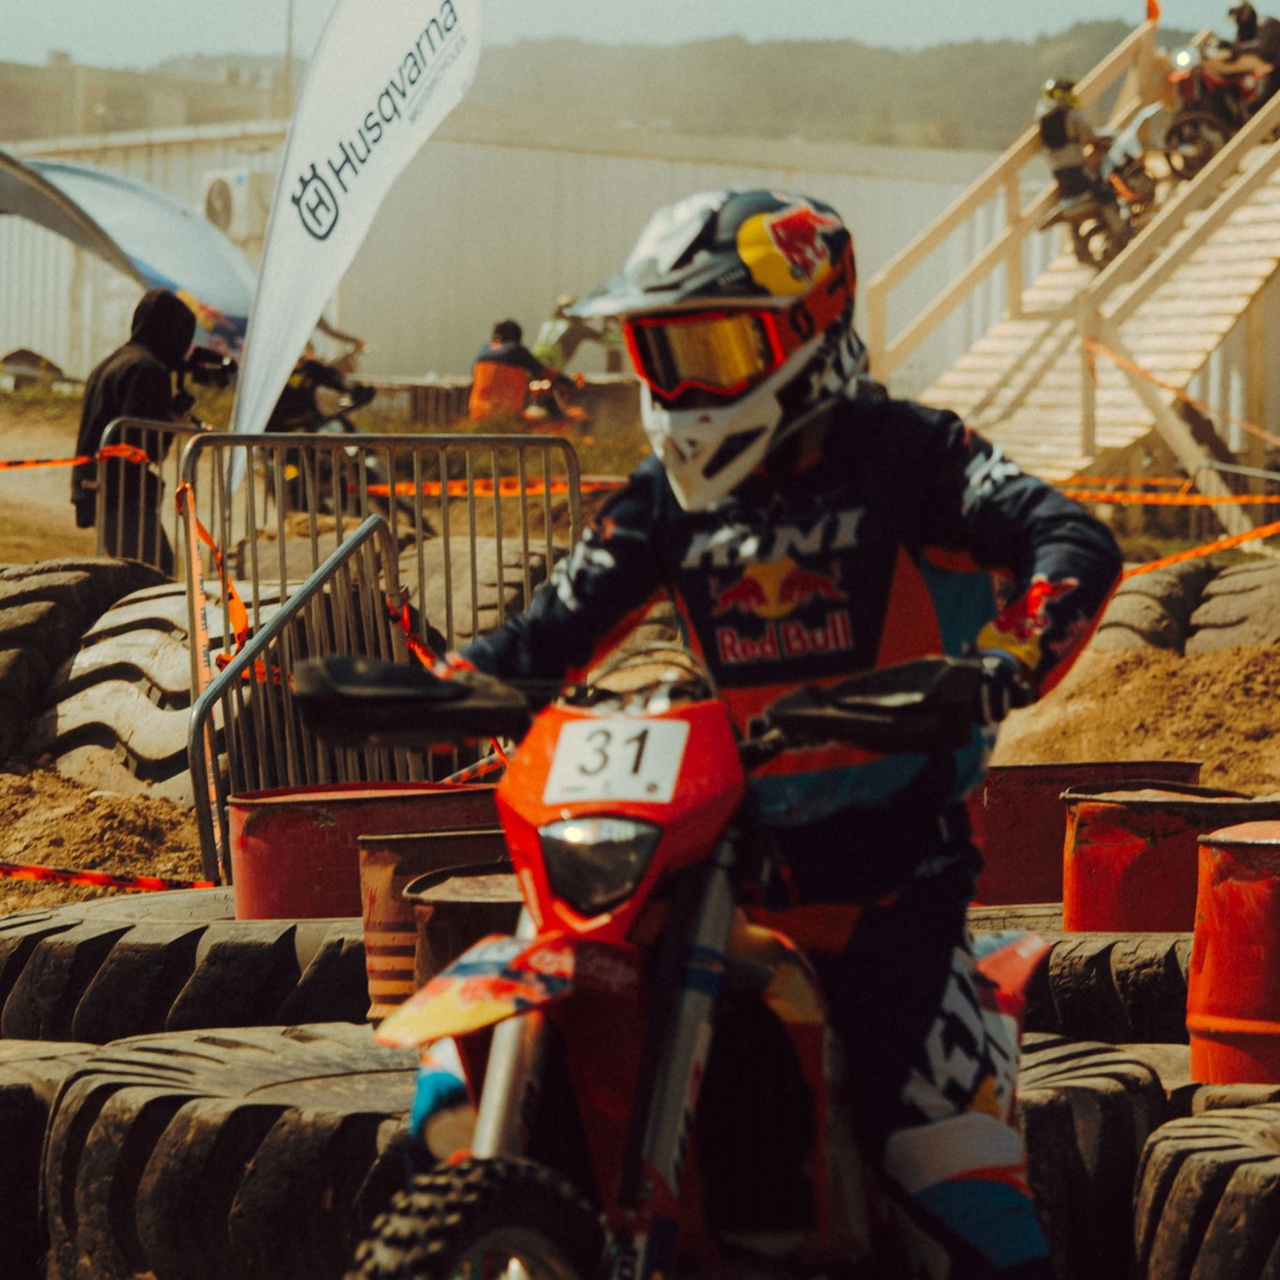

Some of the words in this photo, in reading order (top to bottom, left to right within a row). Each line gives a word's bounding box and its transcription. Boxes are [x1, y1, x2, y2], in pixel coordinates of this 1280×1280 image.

[717, 622, 780, 663] Red
[781, 611, 852, 657] Bull
[578, 729, 649, 776] 31
